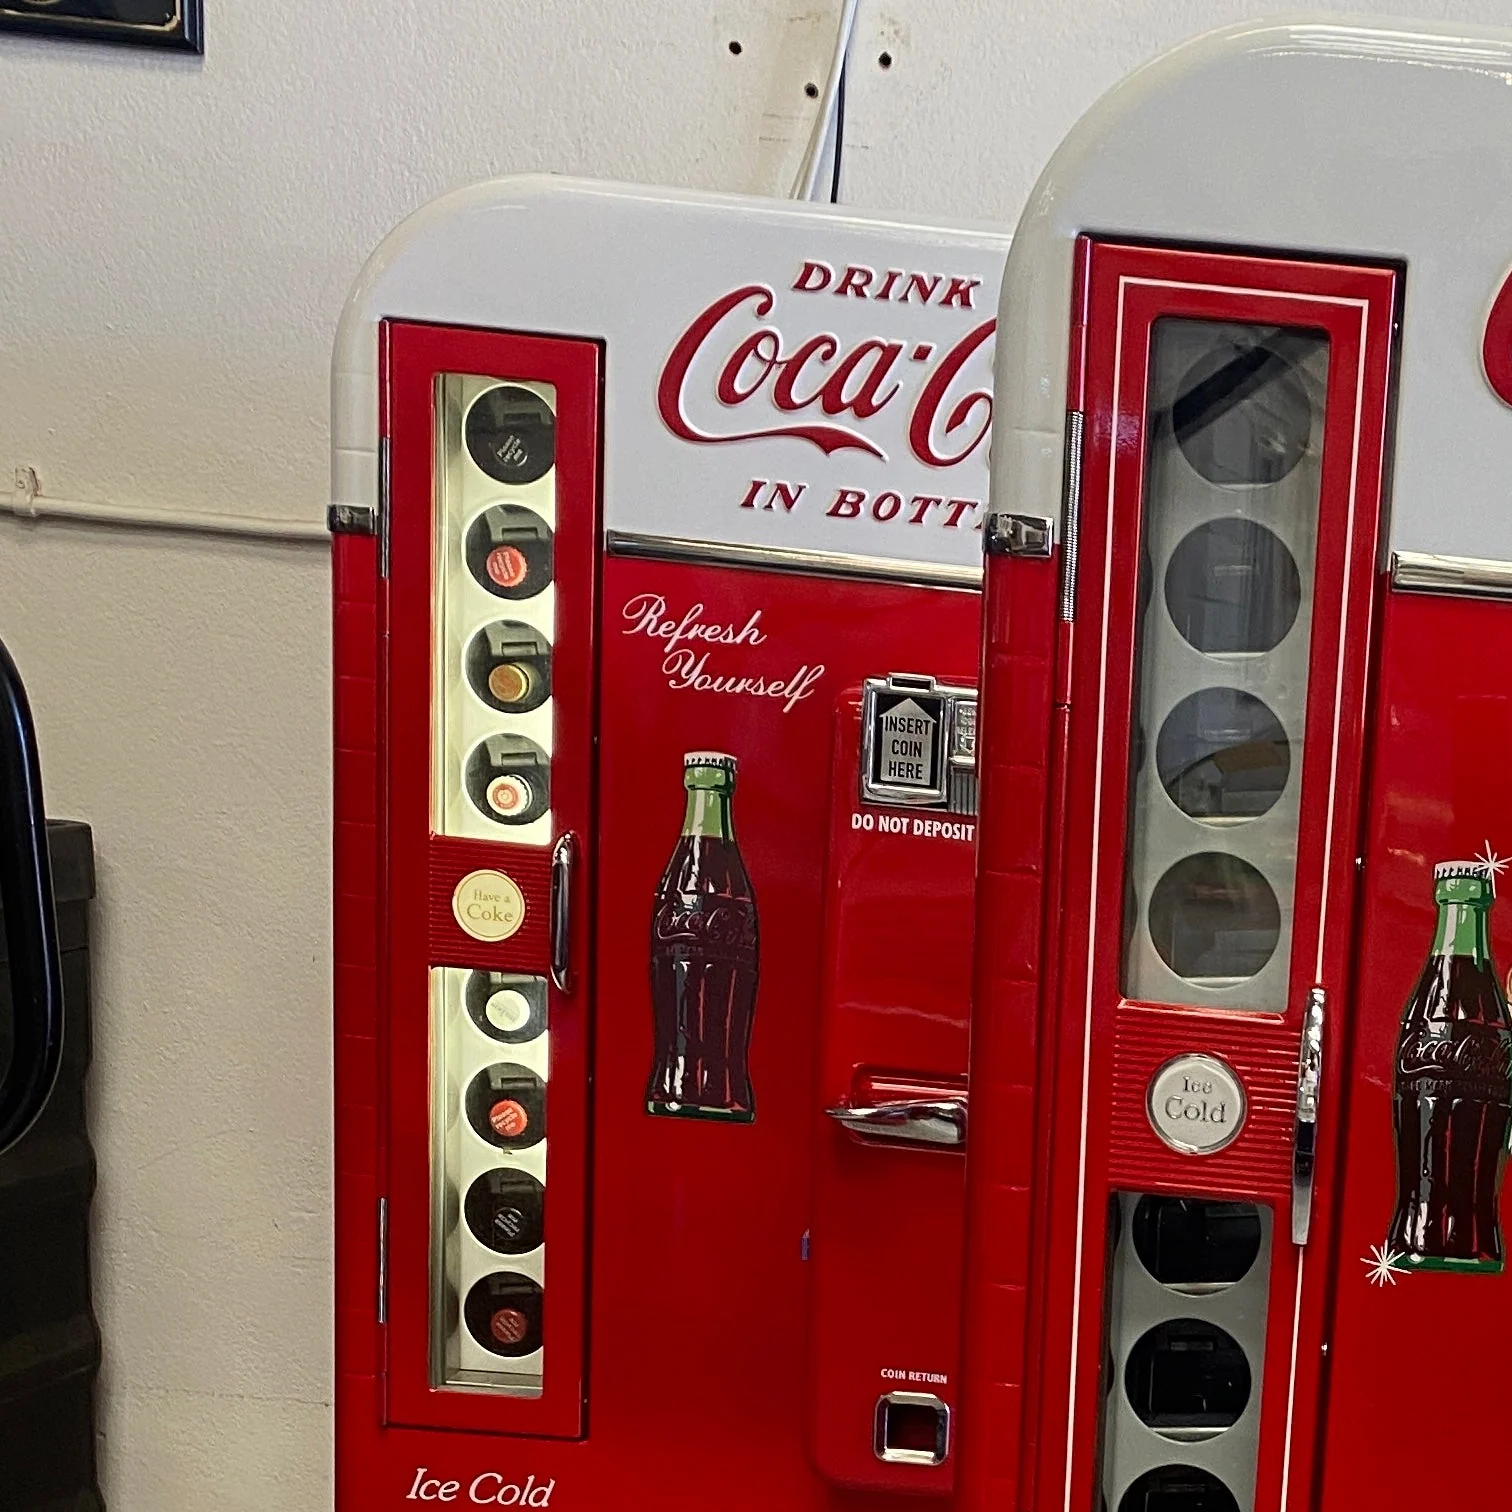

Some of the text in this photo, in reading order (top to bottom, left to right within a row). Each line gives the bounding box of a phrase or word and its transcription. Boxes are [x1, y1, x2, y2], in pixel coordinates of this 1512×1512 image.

[792, 261, 982, 308] DRINK
[657, 284, 997, 467] Coca-C
[741, 480, 983, 529] IN BOTT
[622, 593, 767, 652] Refresh
[662, 649, 825, 713] Yourself
[885, 716, 931, 735] INSERT
[891, 740, 923, 758] COIN
[888, 761, 924, 779] HERE
[851, 813, 975, 841] DO NOT DEPOSIT
[473, 889, 500, 902] Have
[467, 903, 513, 922] Coke
[1183, 1076, 1213, 1094] Ice
[1165, 1095, 1227, 1123] Cold
[880, 1368, 948, 1384] COIN RETURN
[406, 1467, 556, 1508] Ice Cold
